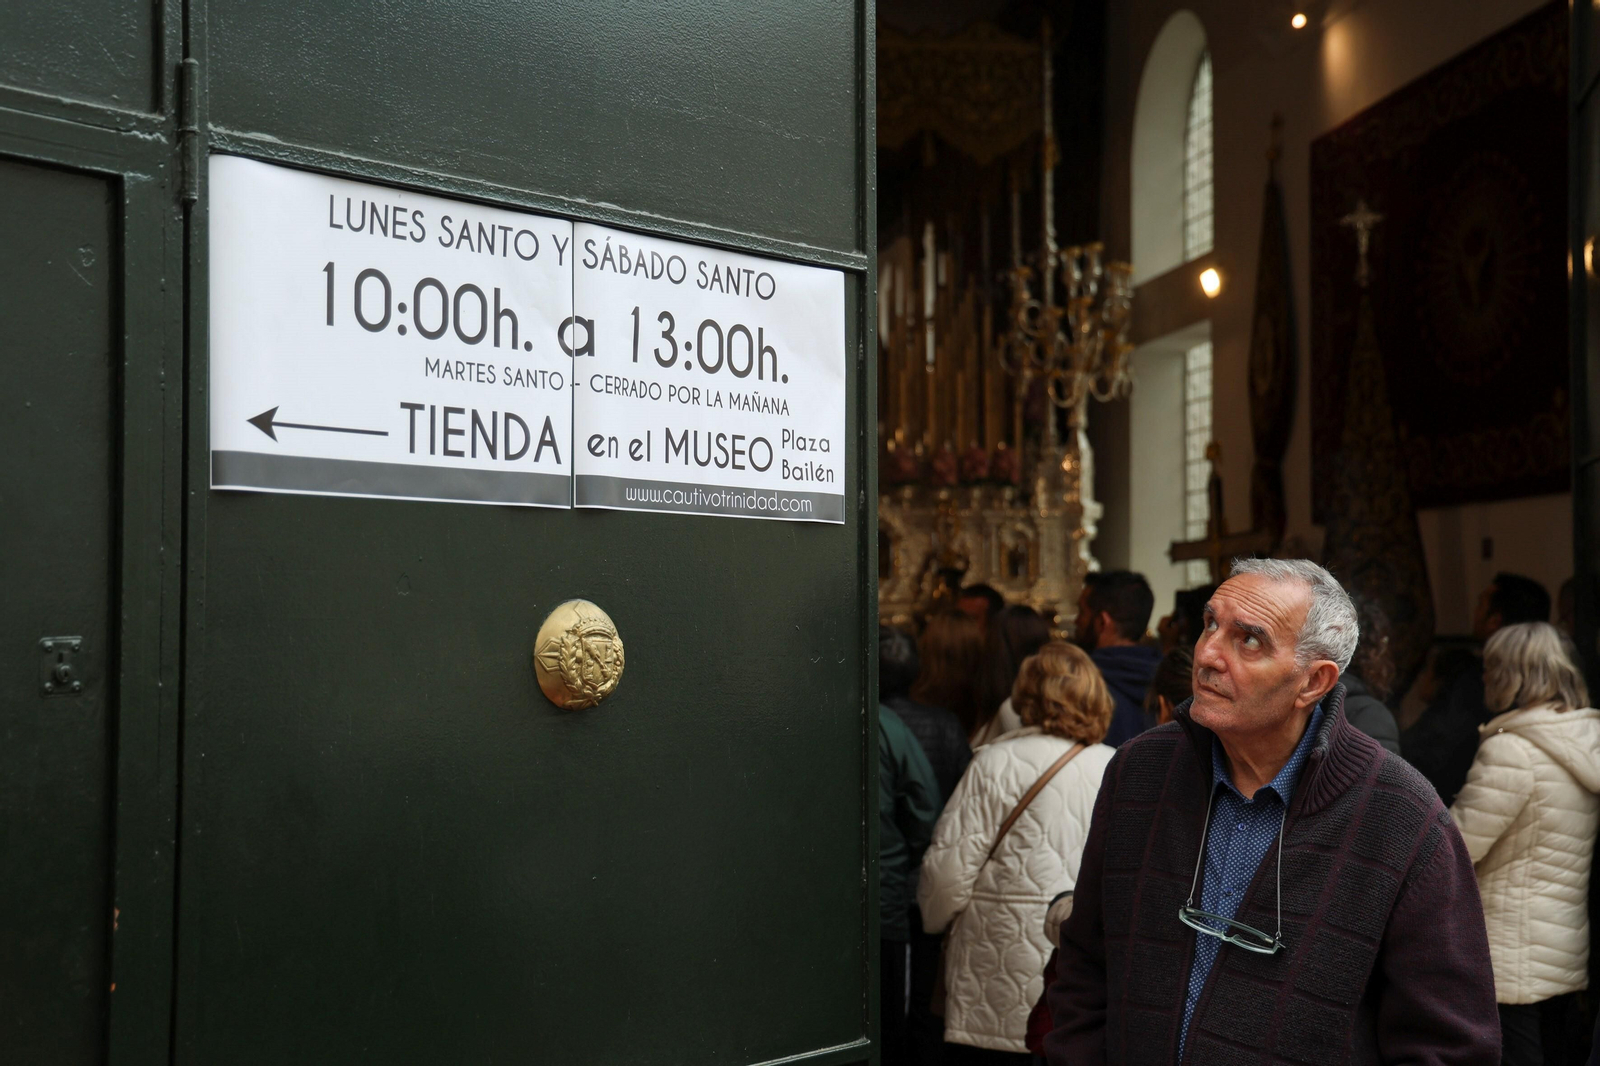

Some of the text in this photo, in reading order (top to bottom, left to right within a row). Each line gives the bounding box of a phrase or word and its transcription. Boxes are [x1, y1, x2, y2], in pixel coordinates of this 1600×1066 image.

[329, 194, 776, 300] LUNES SANTO Y SÁBADO SANTO
[322, 261, 789, 384] 10:00h. a 13:00h.
[425, 357, 496, 384] MARTES
[503, 367, 564, 391] SANTO
[590, 374, 662, 401] CERRADO
[668, 384, 700, 406] POR
[706, 389, 723, 408] LA
[729, 391, 790, 416] MAÑANA
[400, 402, 773, 472] TIENDA en el MUSEO
[782, 428, 830, 453] Plaza
[625, 485, 813, 513] www.cautivotrinidad.com
[782, 459, 834, 483] Bailén
